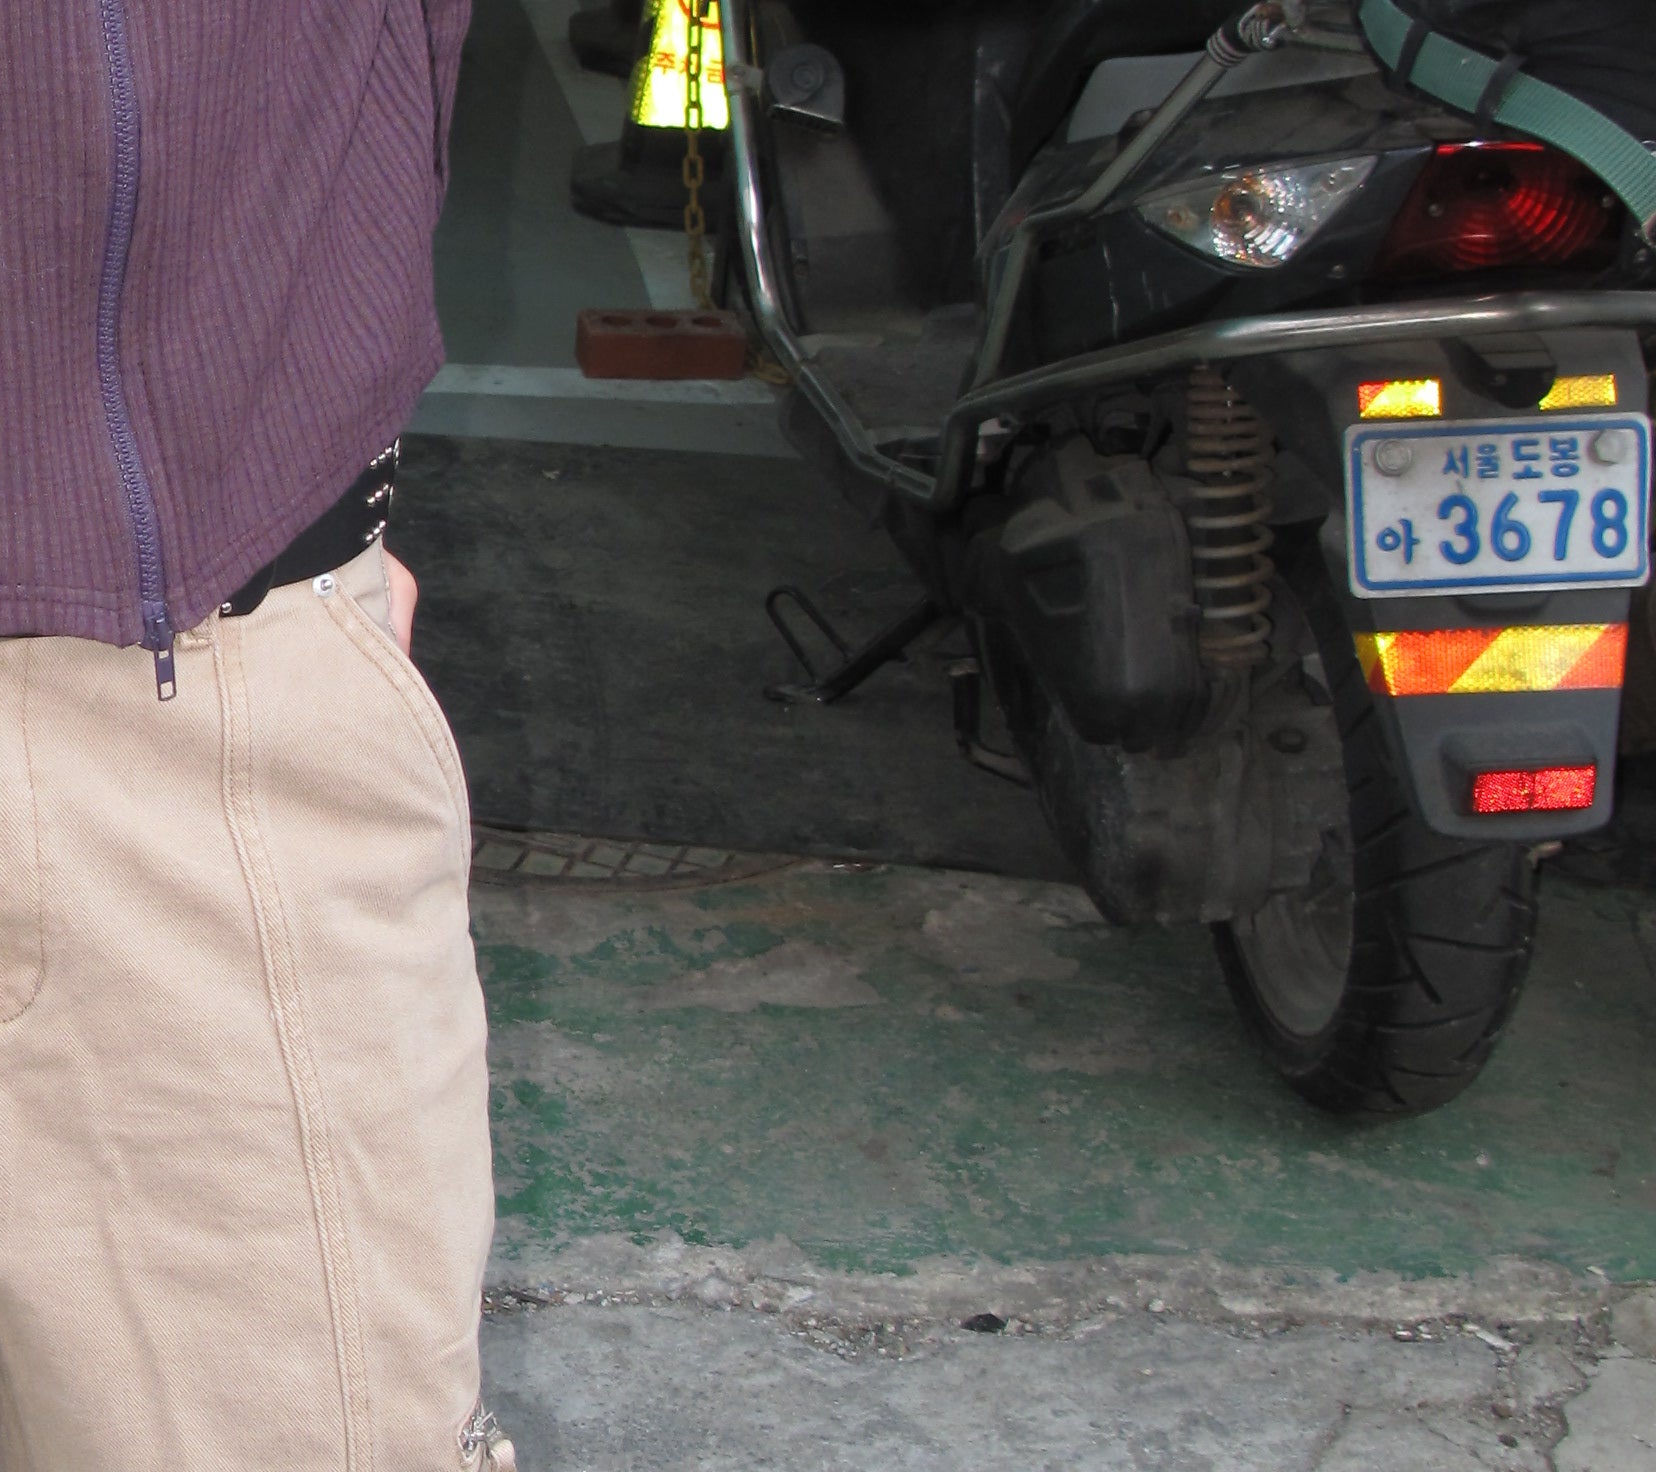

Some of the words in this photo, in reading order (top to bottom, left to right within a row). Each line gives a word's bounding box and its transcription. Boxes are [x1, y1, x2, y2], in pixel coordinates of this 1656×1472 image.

[1442, 445, 1500, 481] 서울
[1511, 436, 1581, 479] 도봉
[1376, 519, 1420, 566] 아
[1438, 487, 1628, 565] 3678
